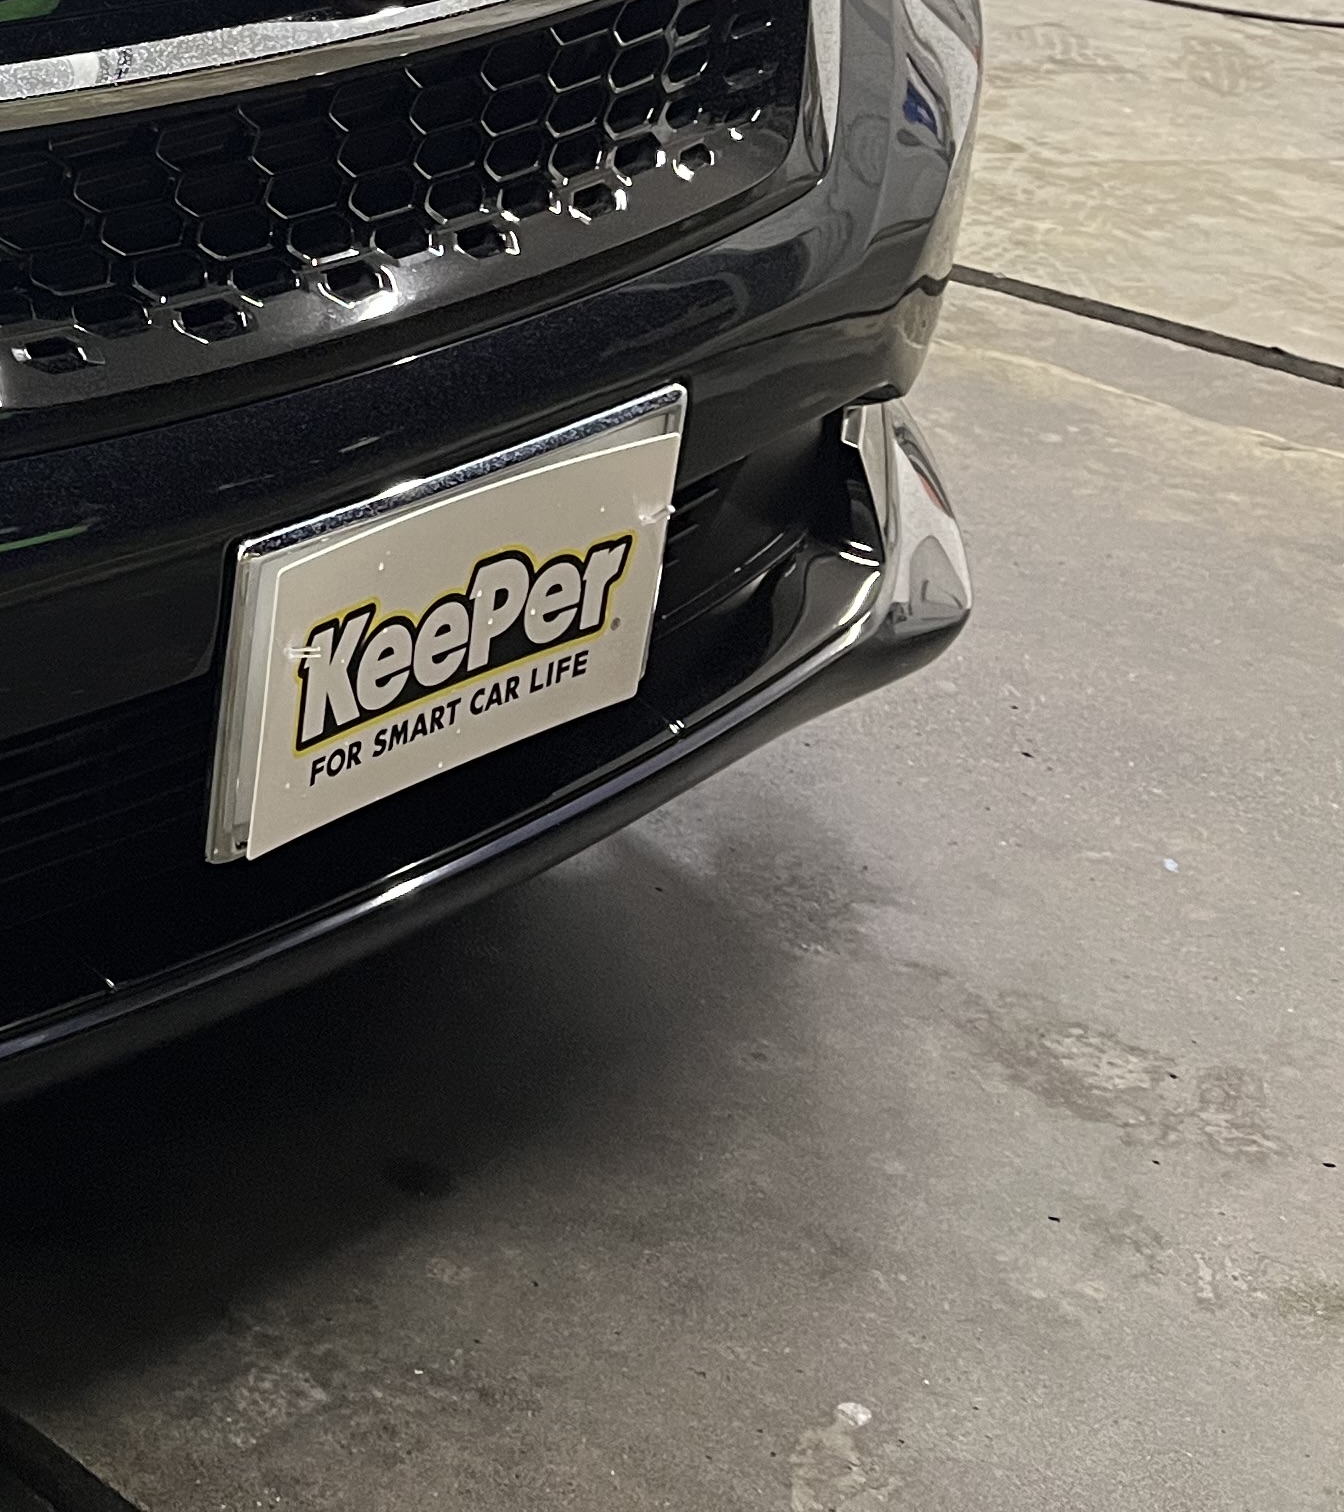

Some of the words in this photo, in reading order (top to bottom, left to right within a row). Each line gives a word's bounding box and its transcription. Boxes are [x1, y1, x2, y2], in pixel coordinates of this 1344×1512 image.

[296, 535, 632, 751] KeePer
[309, 741, 362, 787] FOR
[372, 698, 461, 758] SMART
[469, 675, 521, 716] CAR
[529, 649, 589, 693] LIFE
